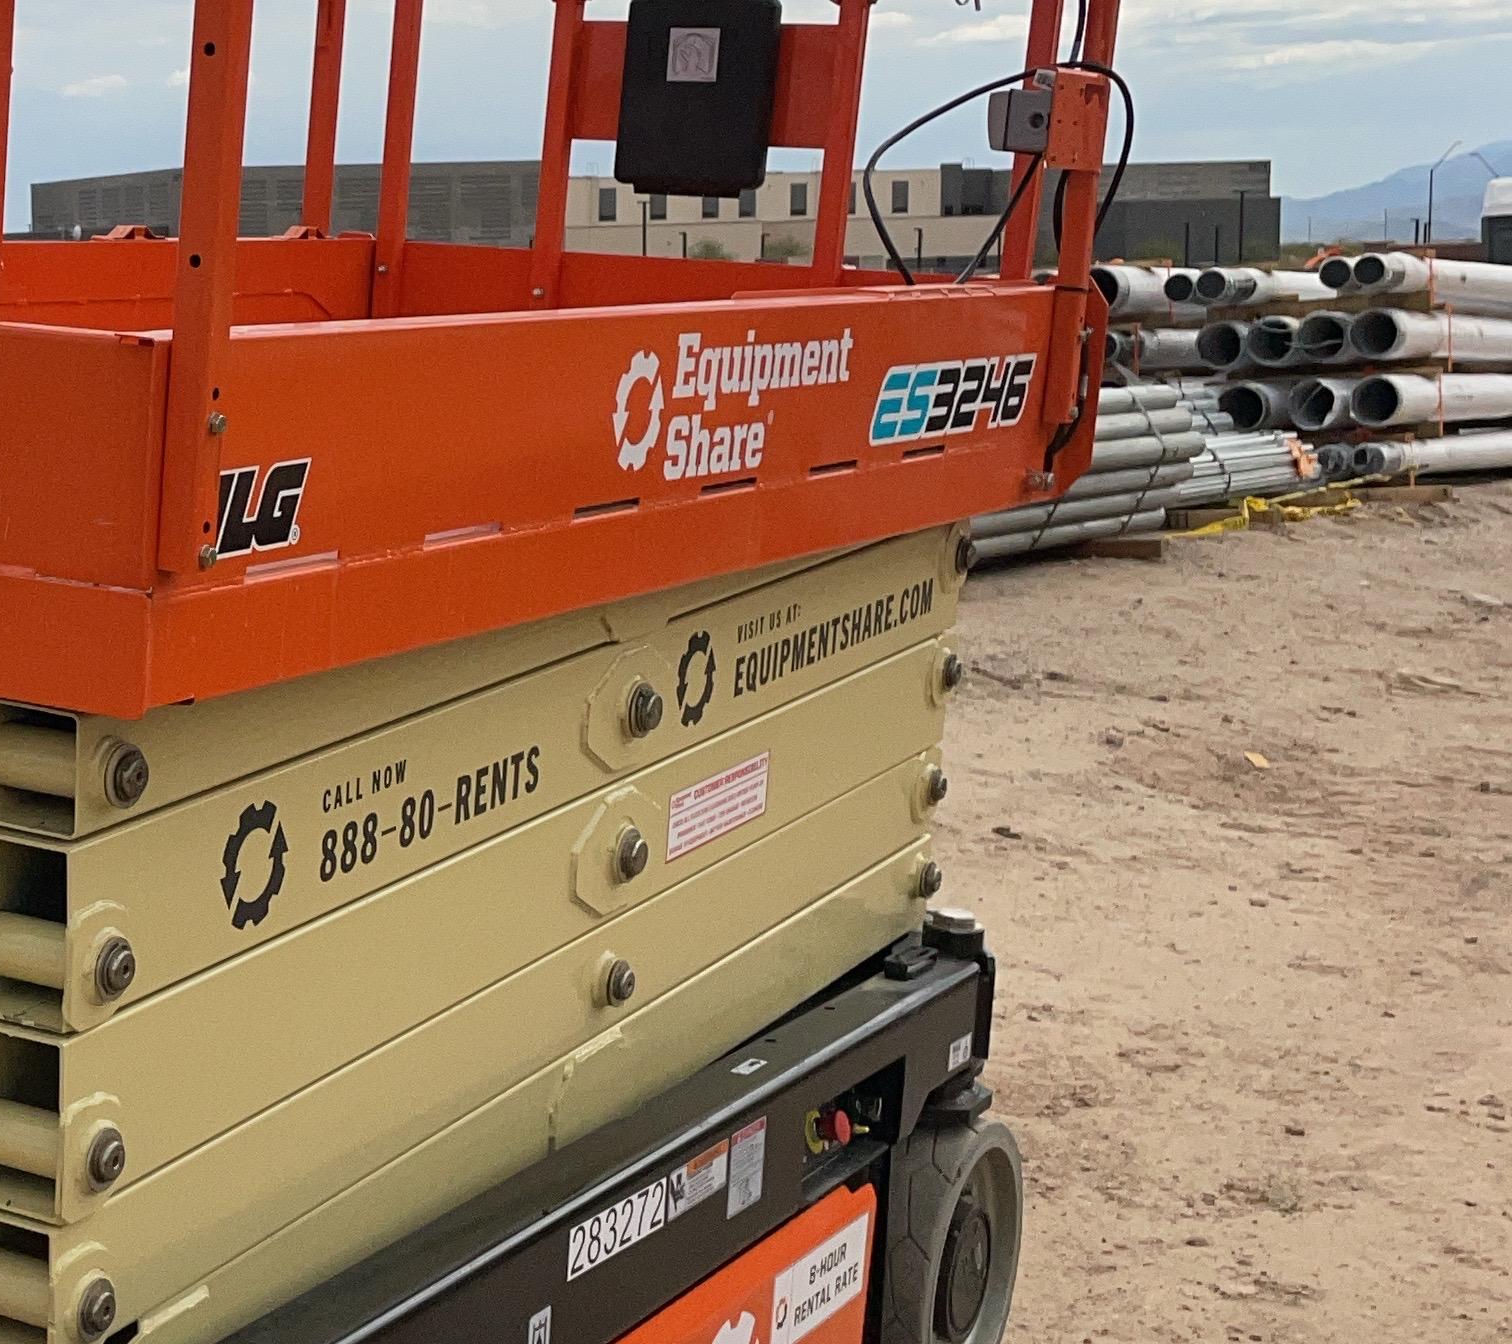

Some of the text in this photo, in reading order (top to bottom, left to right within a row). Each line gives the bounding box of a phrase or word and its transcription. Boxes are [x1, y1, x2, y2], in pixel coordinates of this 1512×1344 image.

[673, 327, 854, 412] Equipment
[868, 353, 1039, 447] ES3246
[662, 413, 765, 481] Share
[734, 579, 934, 698] EQUIPMENTSHARE.COM
[736, 617, 764, 644] VISIT
[768, 611, 782, 630] US
[319, 746, 541, 883] 888-80-RENTS
[323, 759, 408, 813] CALL NOW
[570, 1180, 665, 1276] 283272
[793, 1262, 859, 1327] RENTAL RATE
